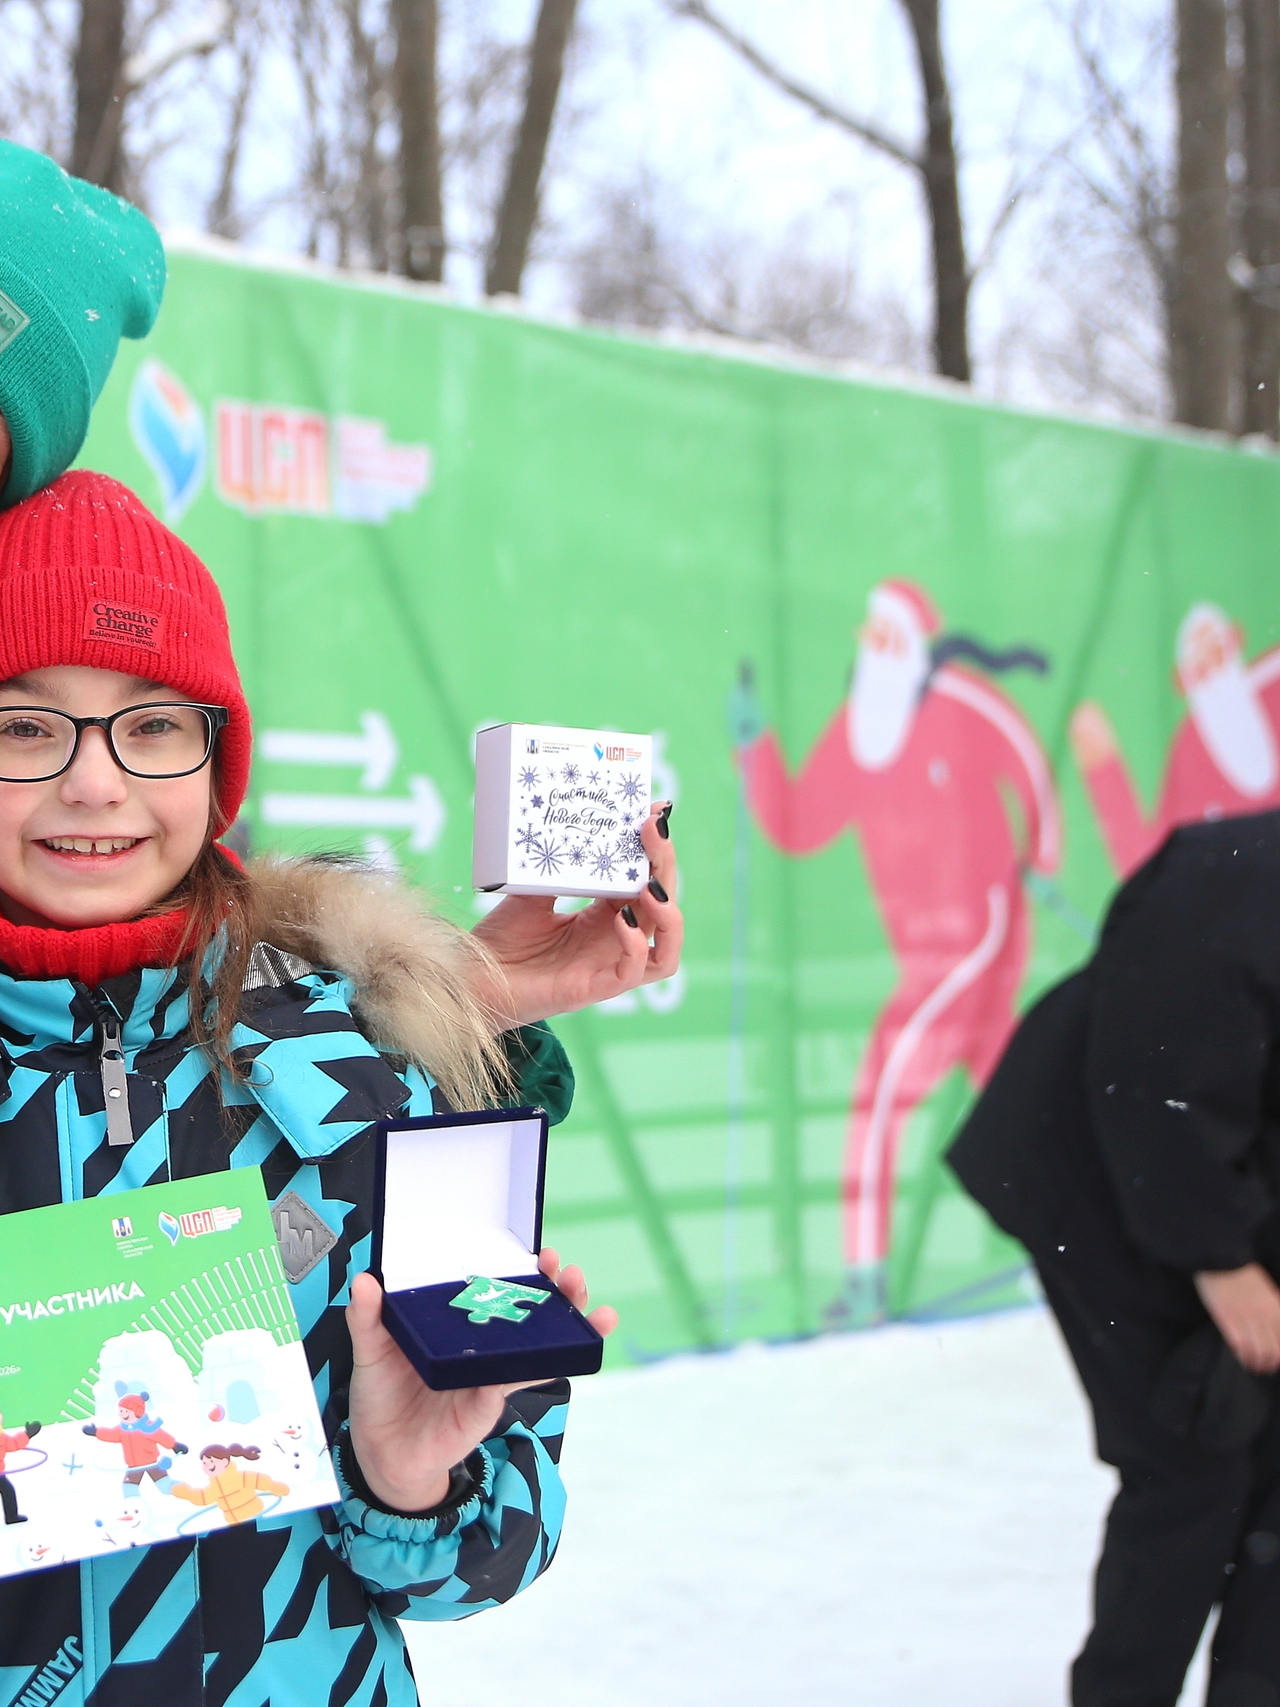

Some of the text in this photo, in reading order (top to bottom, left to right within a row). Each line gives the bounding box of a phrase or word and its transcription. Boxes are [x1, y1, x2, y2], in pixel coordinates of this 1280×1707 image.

[93, 603, 158, 627] Creative
[96, 615, 153, 638] charge
[606, 746, 625, 762] ЦСП
[548, 787, 619, 813] Счастливого
[581, 807, 618, 835] Года
[180, 1210, 214, 1237] ЦСП
